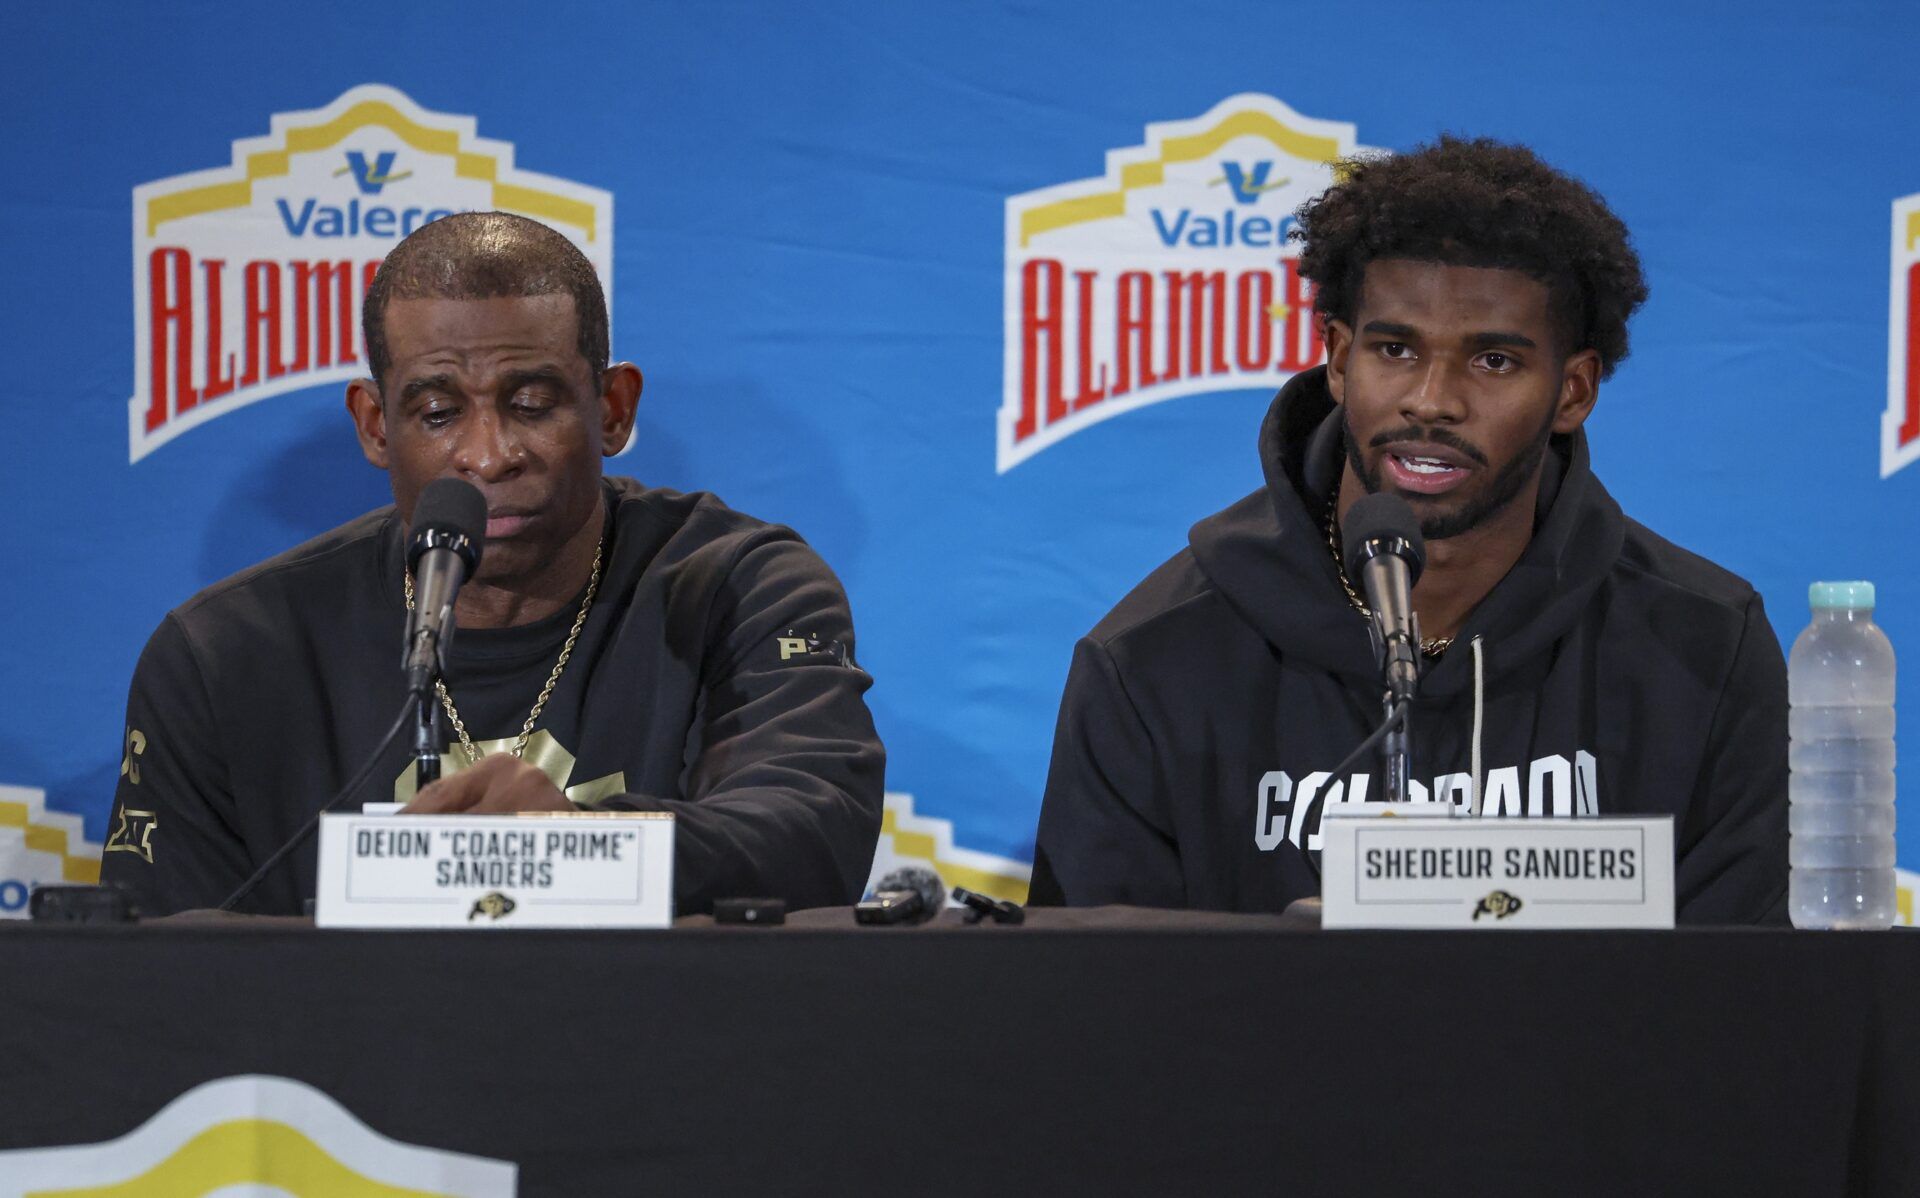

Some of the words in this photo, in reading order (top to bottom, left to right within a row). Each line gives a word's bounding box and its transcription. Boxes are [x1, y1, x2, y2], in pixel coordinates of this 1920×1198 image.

[357, 830, 430, 858] DEION
[440, 831, 536, 859] "COACH
[546, 832, 635, 860] PRIME"
[436, 859, 554, 887] SANDERS
[1366, 848, 1492, 879] SHEDEUR
[1505, 848, 1636, 879] SANDERS
